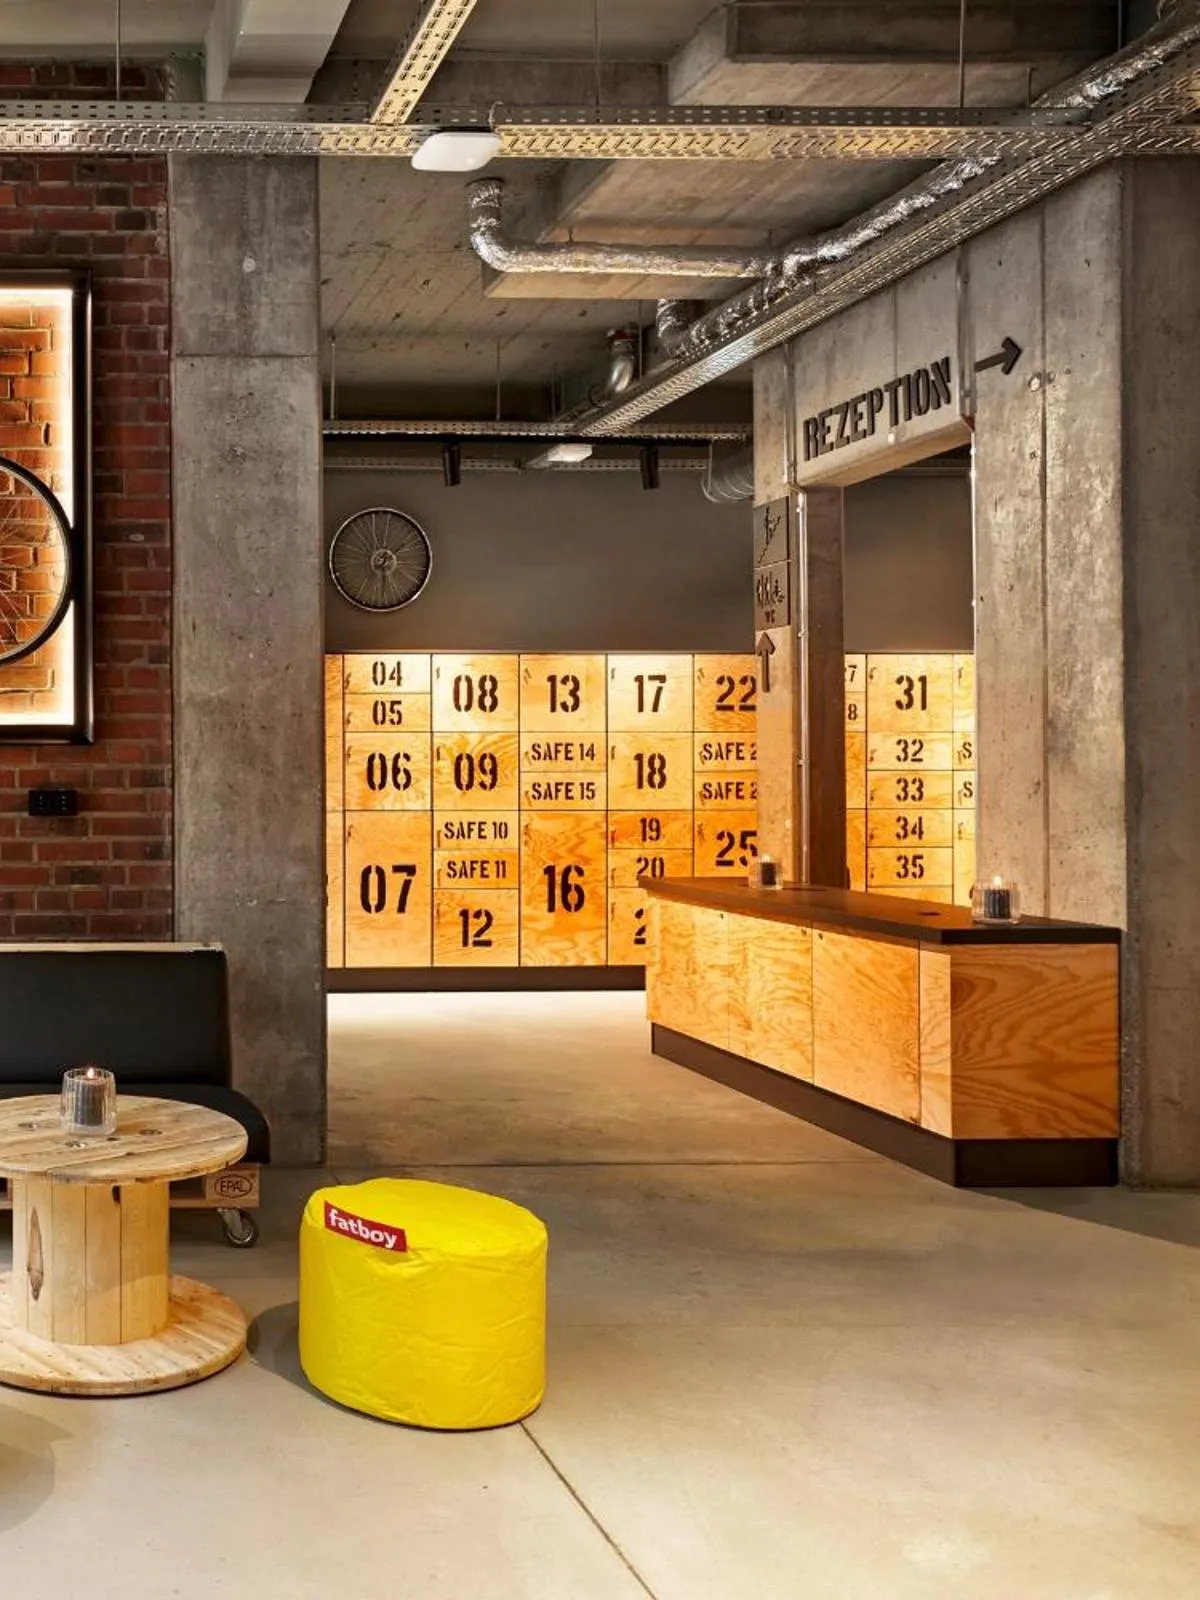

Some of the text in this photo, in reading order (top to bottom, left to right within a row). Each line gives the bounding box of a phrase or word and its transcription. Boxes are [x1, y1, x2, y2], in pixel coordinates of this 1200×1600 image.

[803, 356, 951, 461] REZEPTION
[372, 661, 402, 687] 04
[453, 675, 498, 713] 08
[547, 674, 580, 713] 13
[633, 675, 667, 713] 17
[716, 675, 757, 711] 22
[895, 675, 927, 711] 31
[373, 700, 402, 725] 05
[531, 743, 595, 761] SAFE 14
[703, 743, 745, 761] SAFE
[896, 739, 924, 762] 32
[367, 753, 412, 791] 06
[454, 753, 498, 791] 09
[633, 753, 667, 789] 18
[531, 782, 596, 801] SAFE 15
[703, 782, 745, 800] SAFE
[896, 777, 924, 802] 33
[444, 822, 508, 840] SAFE 10
[639, 817, 661, 842] 19
[896, 815, 924, 841] 34
[716, 830, 757, 867] 25
[447, 860, 507, 879] SAFE 11
[636, 857, 664, 879] 20
[896, 855, 924, 880] 35
[360, 865, 417, 914] 07
[543, 864, 585, 913] 16
[459, 908, 494, 948] 12
[220, 1181, 247, 1193] EPAL
[329, 1208, 398, 1249] fatboy
